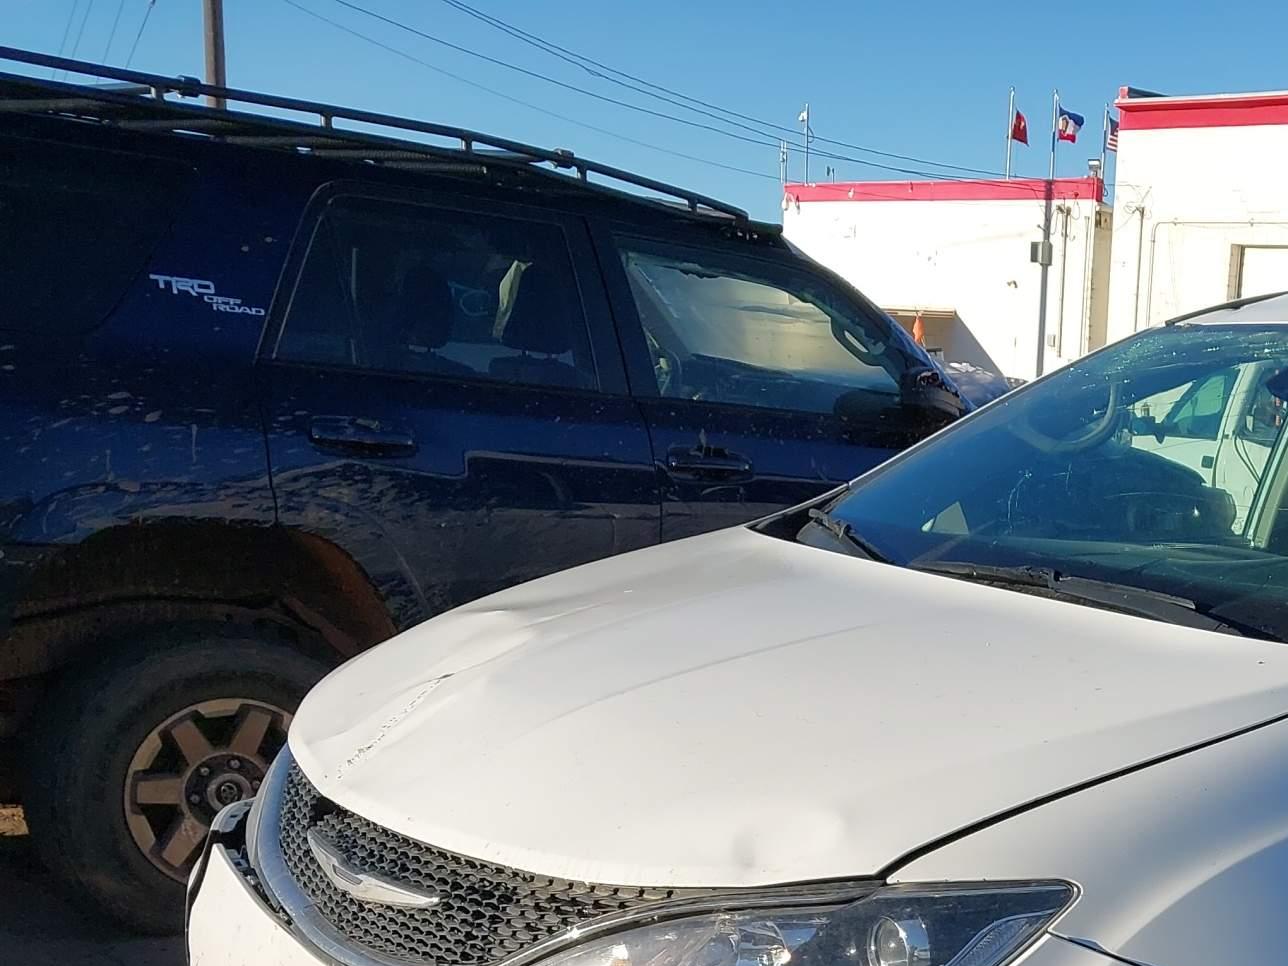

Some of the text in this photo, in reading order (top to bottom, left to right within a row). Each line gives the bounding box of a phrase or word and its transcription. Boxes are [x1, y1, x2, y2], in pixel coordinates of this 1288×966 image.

[149, 273, 215, 296] TRD
[204, 295, 242, 304] OFF
[213, 303, 265, 315] ROAD
